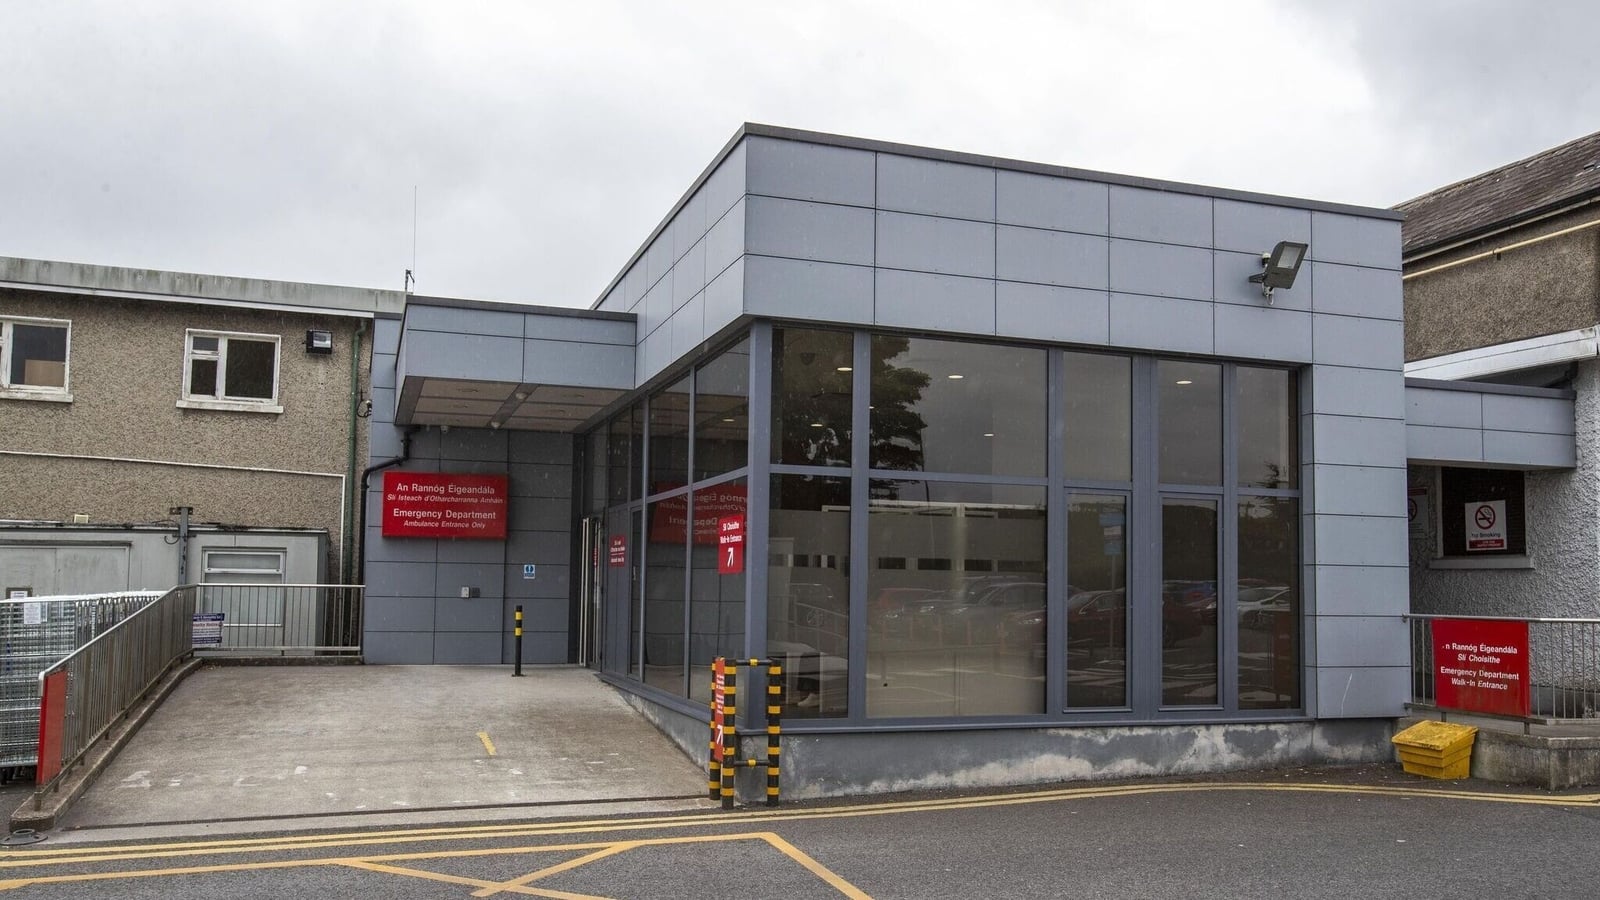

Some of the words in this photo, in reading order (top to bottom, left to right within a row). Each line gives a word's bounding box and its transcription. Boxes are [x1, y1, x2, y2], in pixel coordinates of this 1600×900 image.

[397, 483, 408, 492] An
[412, 483, 445, 493] Rannóg
[448, 483, 495, 494] Éigeandála
[393, 508, 442, 519] Emergency
[446, 510, 496, 520] Department
[404, 520, 439, 528] Ambulance
[472, 521, 486, 529] Only
[1452, 643, 1477, 652] Rannóg
[1480, 643, 1518, 654] Éigeandála
[1457, 653, 1467, 661] Slí
[1468, 654, 1501, 664] Choisithe
[1440, 666, 1477, 677] Emergency
[1479, 669, 1519, 680] Department
[1477, 681, 1508, 690] Entrance
